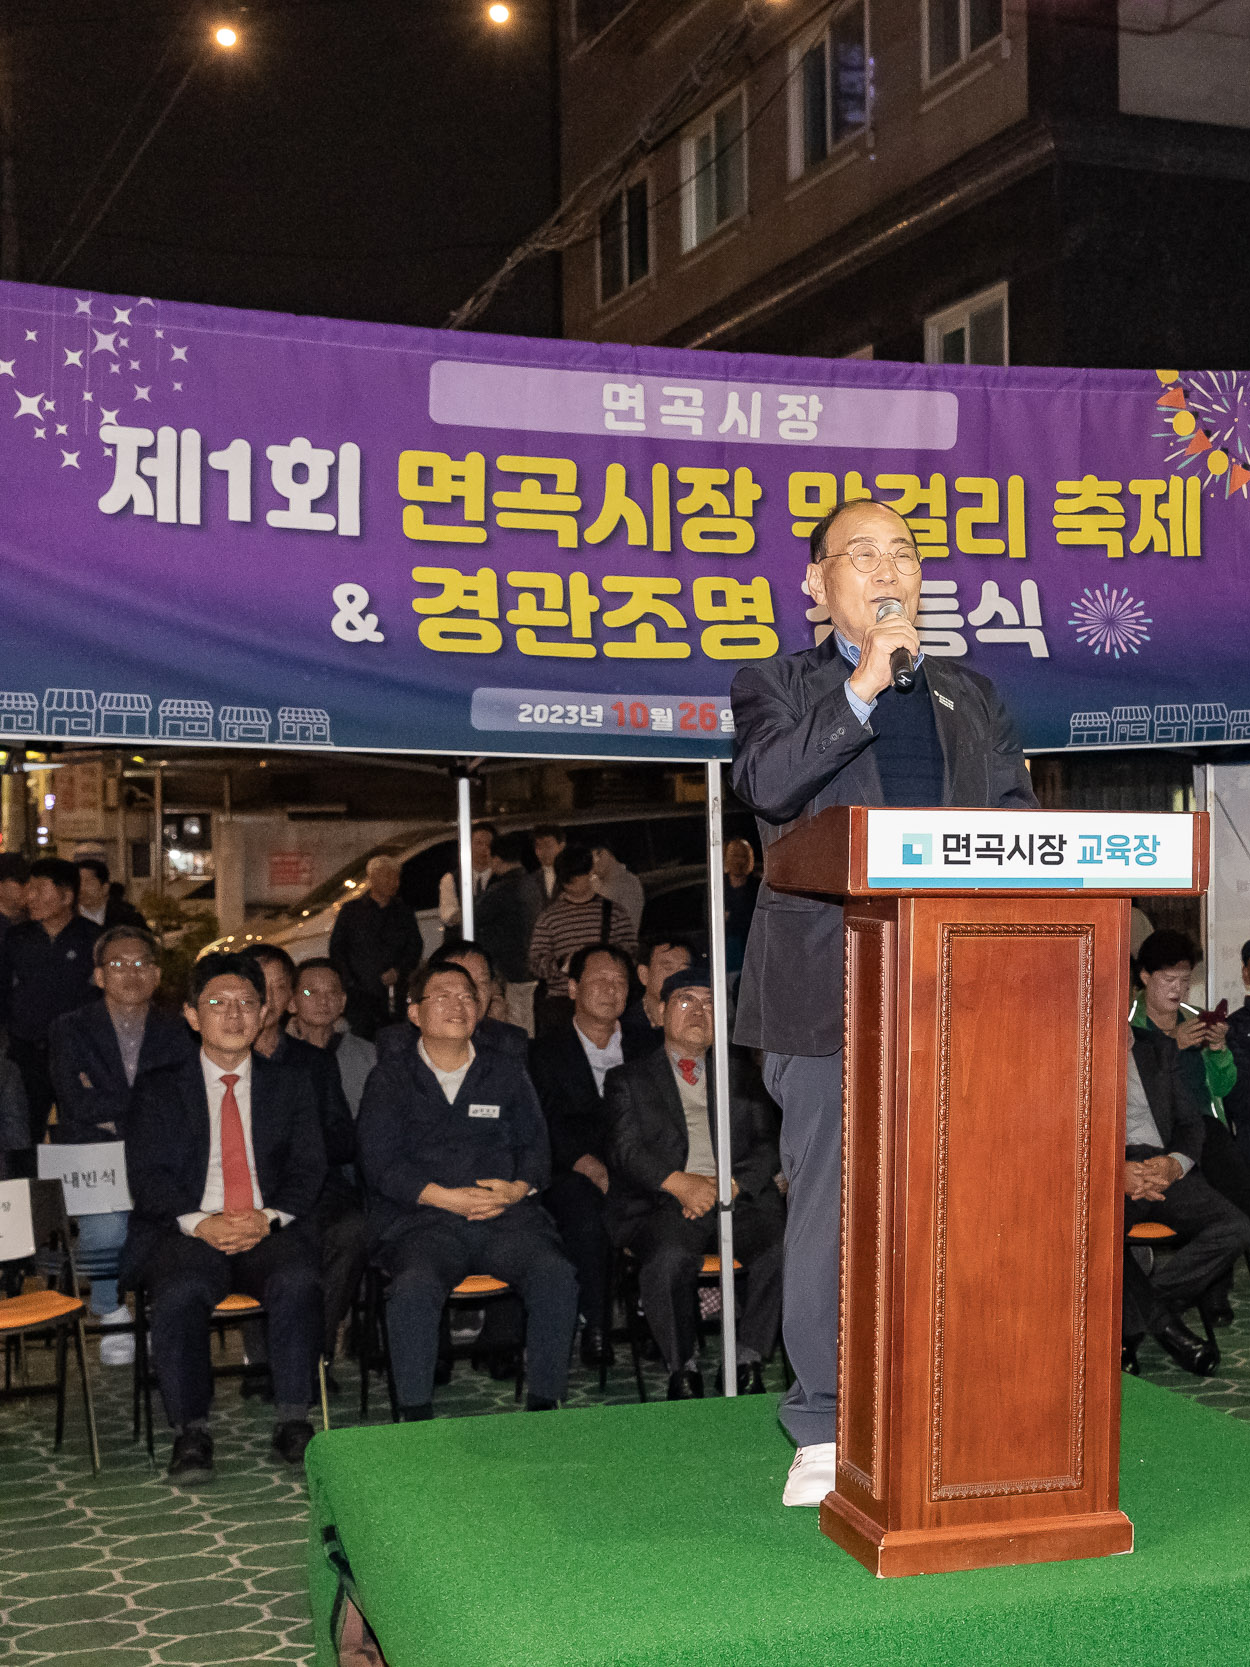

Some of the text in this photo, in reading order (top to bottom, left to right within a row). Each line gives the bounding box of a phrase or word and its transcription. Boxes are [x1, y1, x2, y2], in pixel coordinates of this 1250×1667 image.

[601, 381, 824, 441] 면곡시장
[98, 424, 362, 538] 제1회
[397, 449, 763, 555] 면곡시장
[1052, 473, 1203, 560] 축제
[331, 567, 1050, 661] & 경관조명 등식
[517, 703, 604, 728] 2023년
[611, 701, 674, 732] 10월
[942, 833, 1161, 867] 면곡시장 교육장
[62, 1168, 116, 1189] 내빈석
